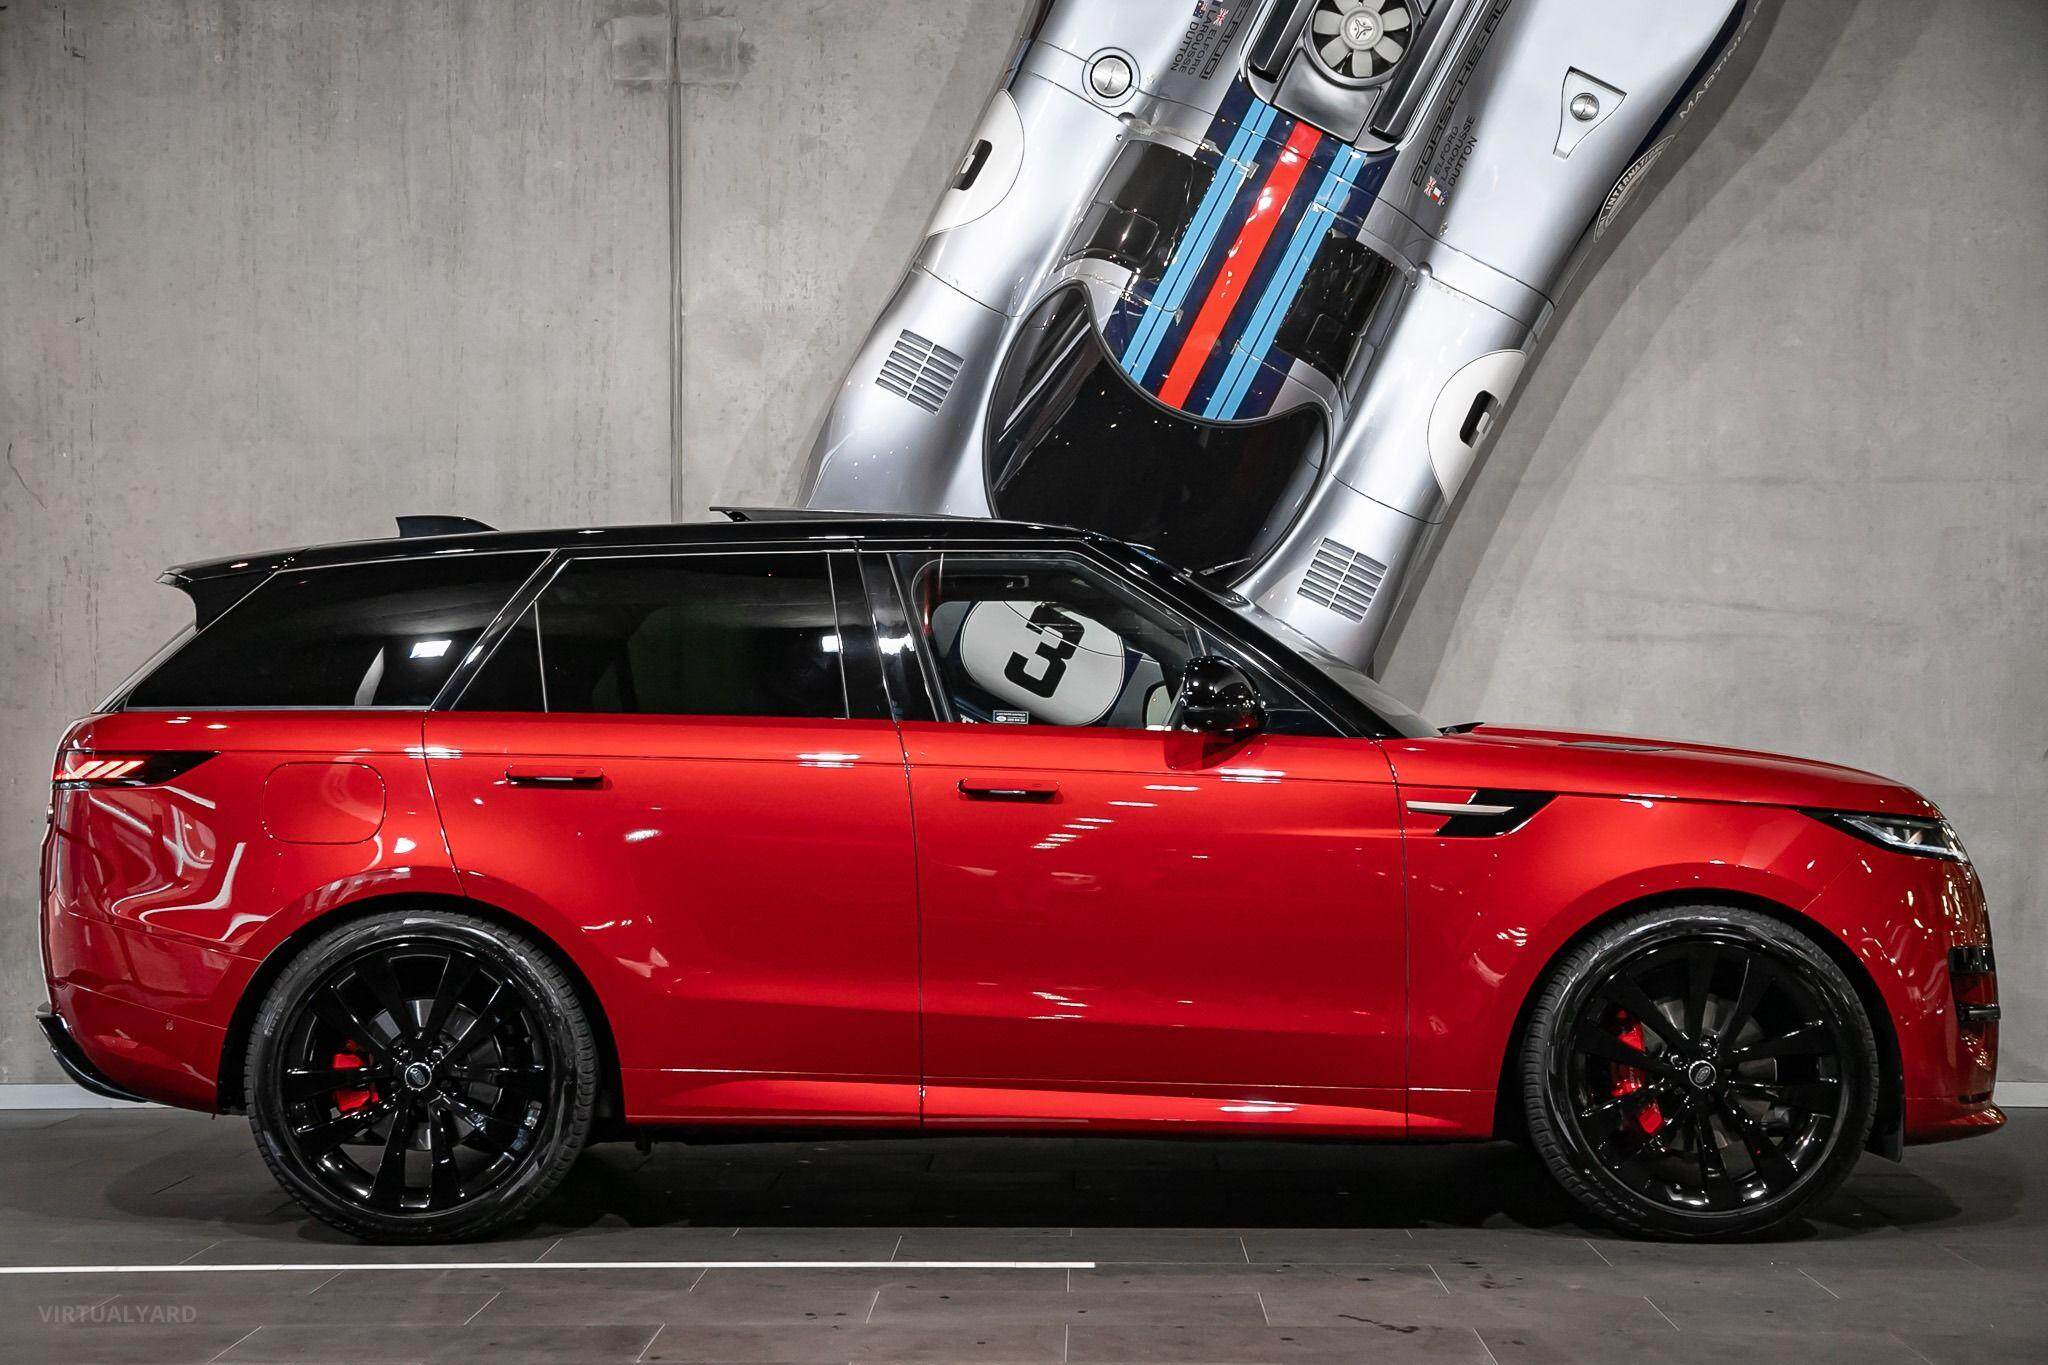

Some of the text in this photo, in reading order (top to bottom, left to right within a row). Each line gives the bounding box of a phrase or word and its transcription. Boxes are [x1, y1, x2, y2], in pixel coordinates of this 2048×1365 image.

[1170, 21, 1199, 71] DUTTON
[1179, 10, 1217, 73] LAROUSSE
[1188, 29, 1217, 75] ELFORD
[1433, 126, 1459, 176] ELFORD
[1441, 115, 1476, 182] LAROUSSE
[1449, 135, 1478, 187] DUTTON
[1004, 603, 1085, 698] 3
